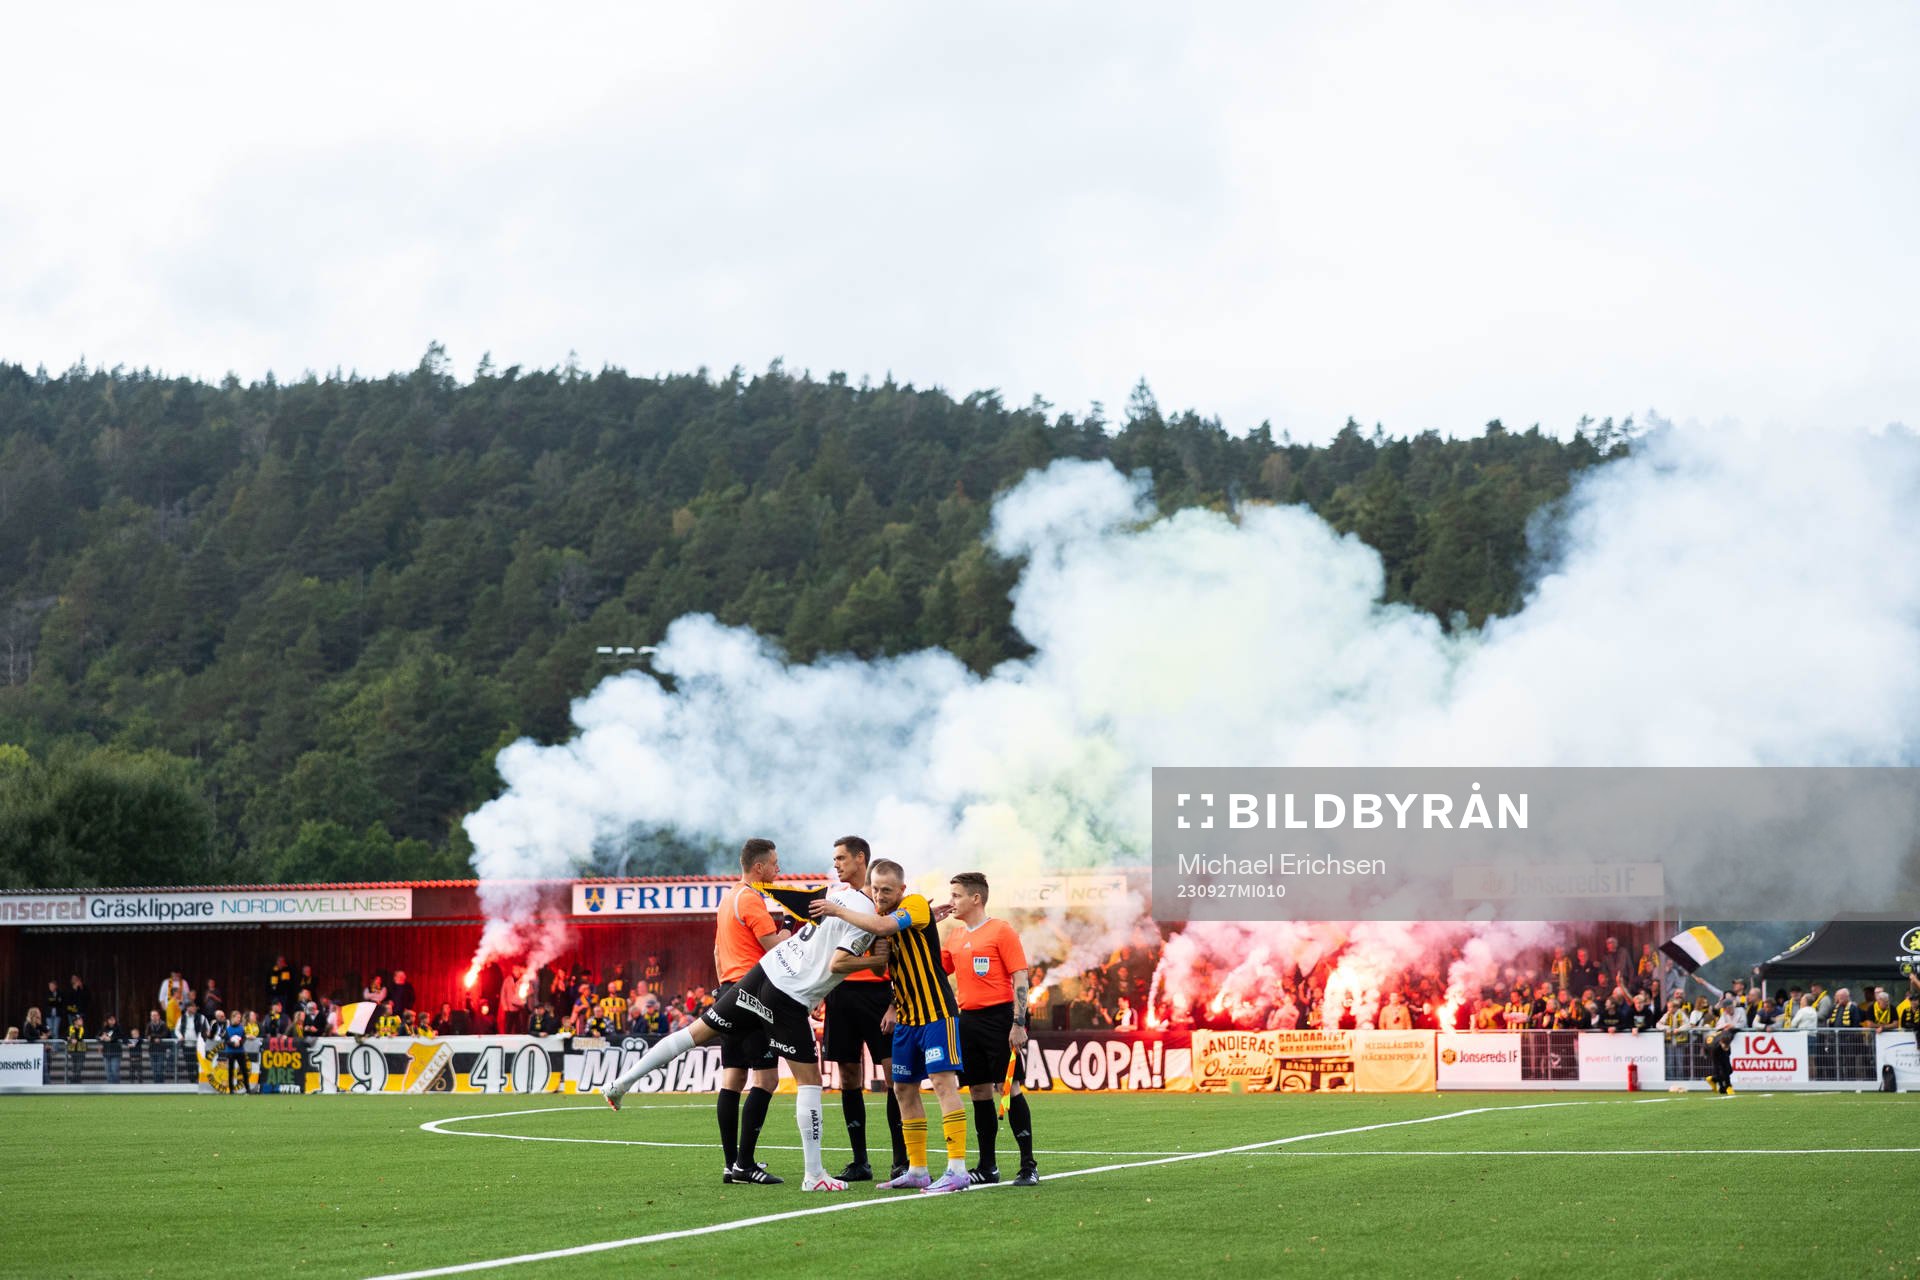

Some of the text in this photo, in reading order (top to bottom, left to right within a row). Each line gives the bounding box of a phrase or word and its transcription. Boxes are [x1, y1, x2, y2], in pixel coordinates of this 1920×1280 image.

[0, 896, 87, 921] nsered
[90, 898, 214, 920] Gräsklippare
[269, 1036, 297, 1051] ALL
[1745, 1036, 1783, 1055] ICA
[262, 1050, 302, 1069] COPS
[1059, 1040, 1164, 1091] COPA!
[1459, 1051, 1517, 1063] Jonsereds IF
[1613, 1055, 1622, 1063] in
[1625, 1055, 1658, 1063] motion
[1735, 1059, 1794, 1070] KVANTUM
[267, 1068, 295, 1085] ARE
[312, 1044, 387, 1093] 19
[470, 1044, 551, 1093] 40
[810, 1109, 819, 1141] MAXXIS
